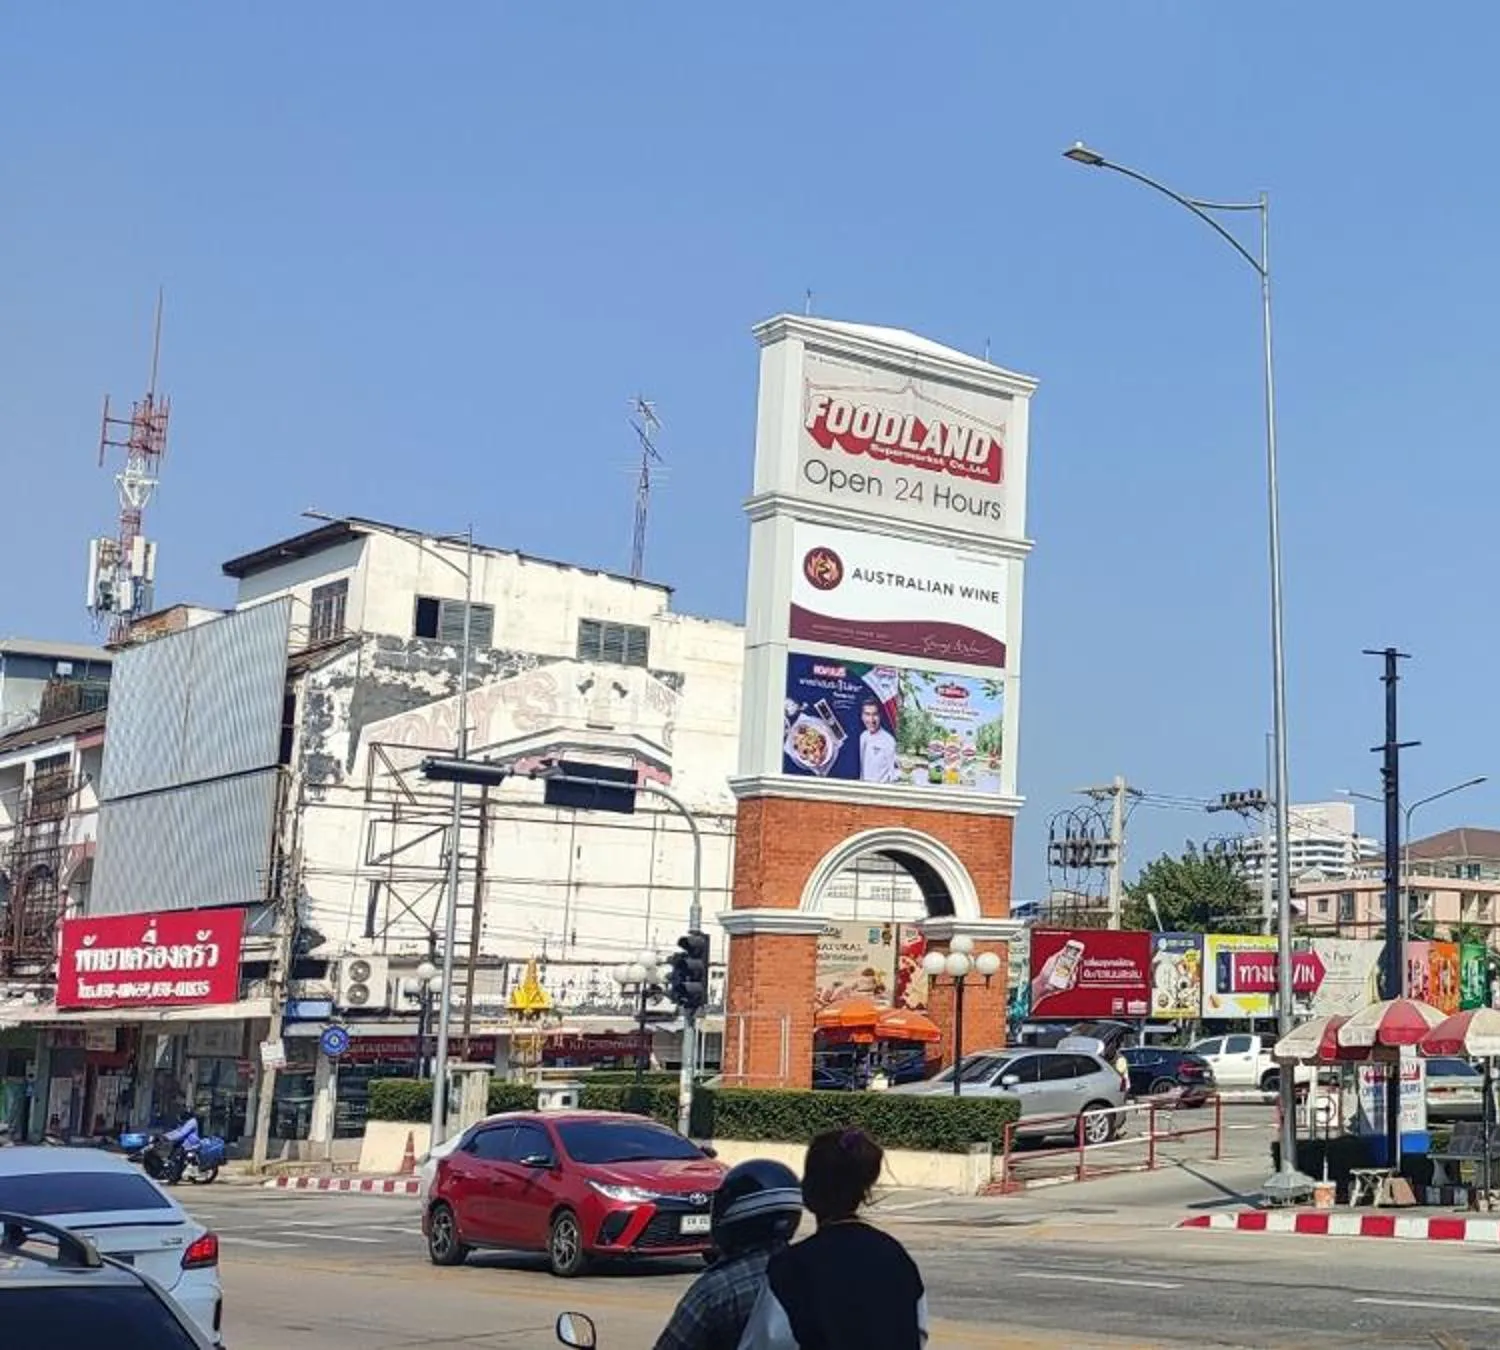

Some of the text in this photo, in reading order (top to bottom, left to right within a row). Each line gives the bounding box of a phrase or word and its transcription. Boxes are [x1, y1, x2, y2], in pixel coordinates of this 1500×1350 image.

[804, 394, 992, 464] FOODLAND
[804, 458, 1001, 521] Open 24 Hours
[852, 567, 1000, 605] AUSTRALIAN WINE
